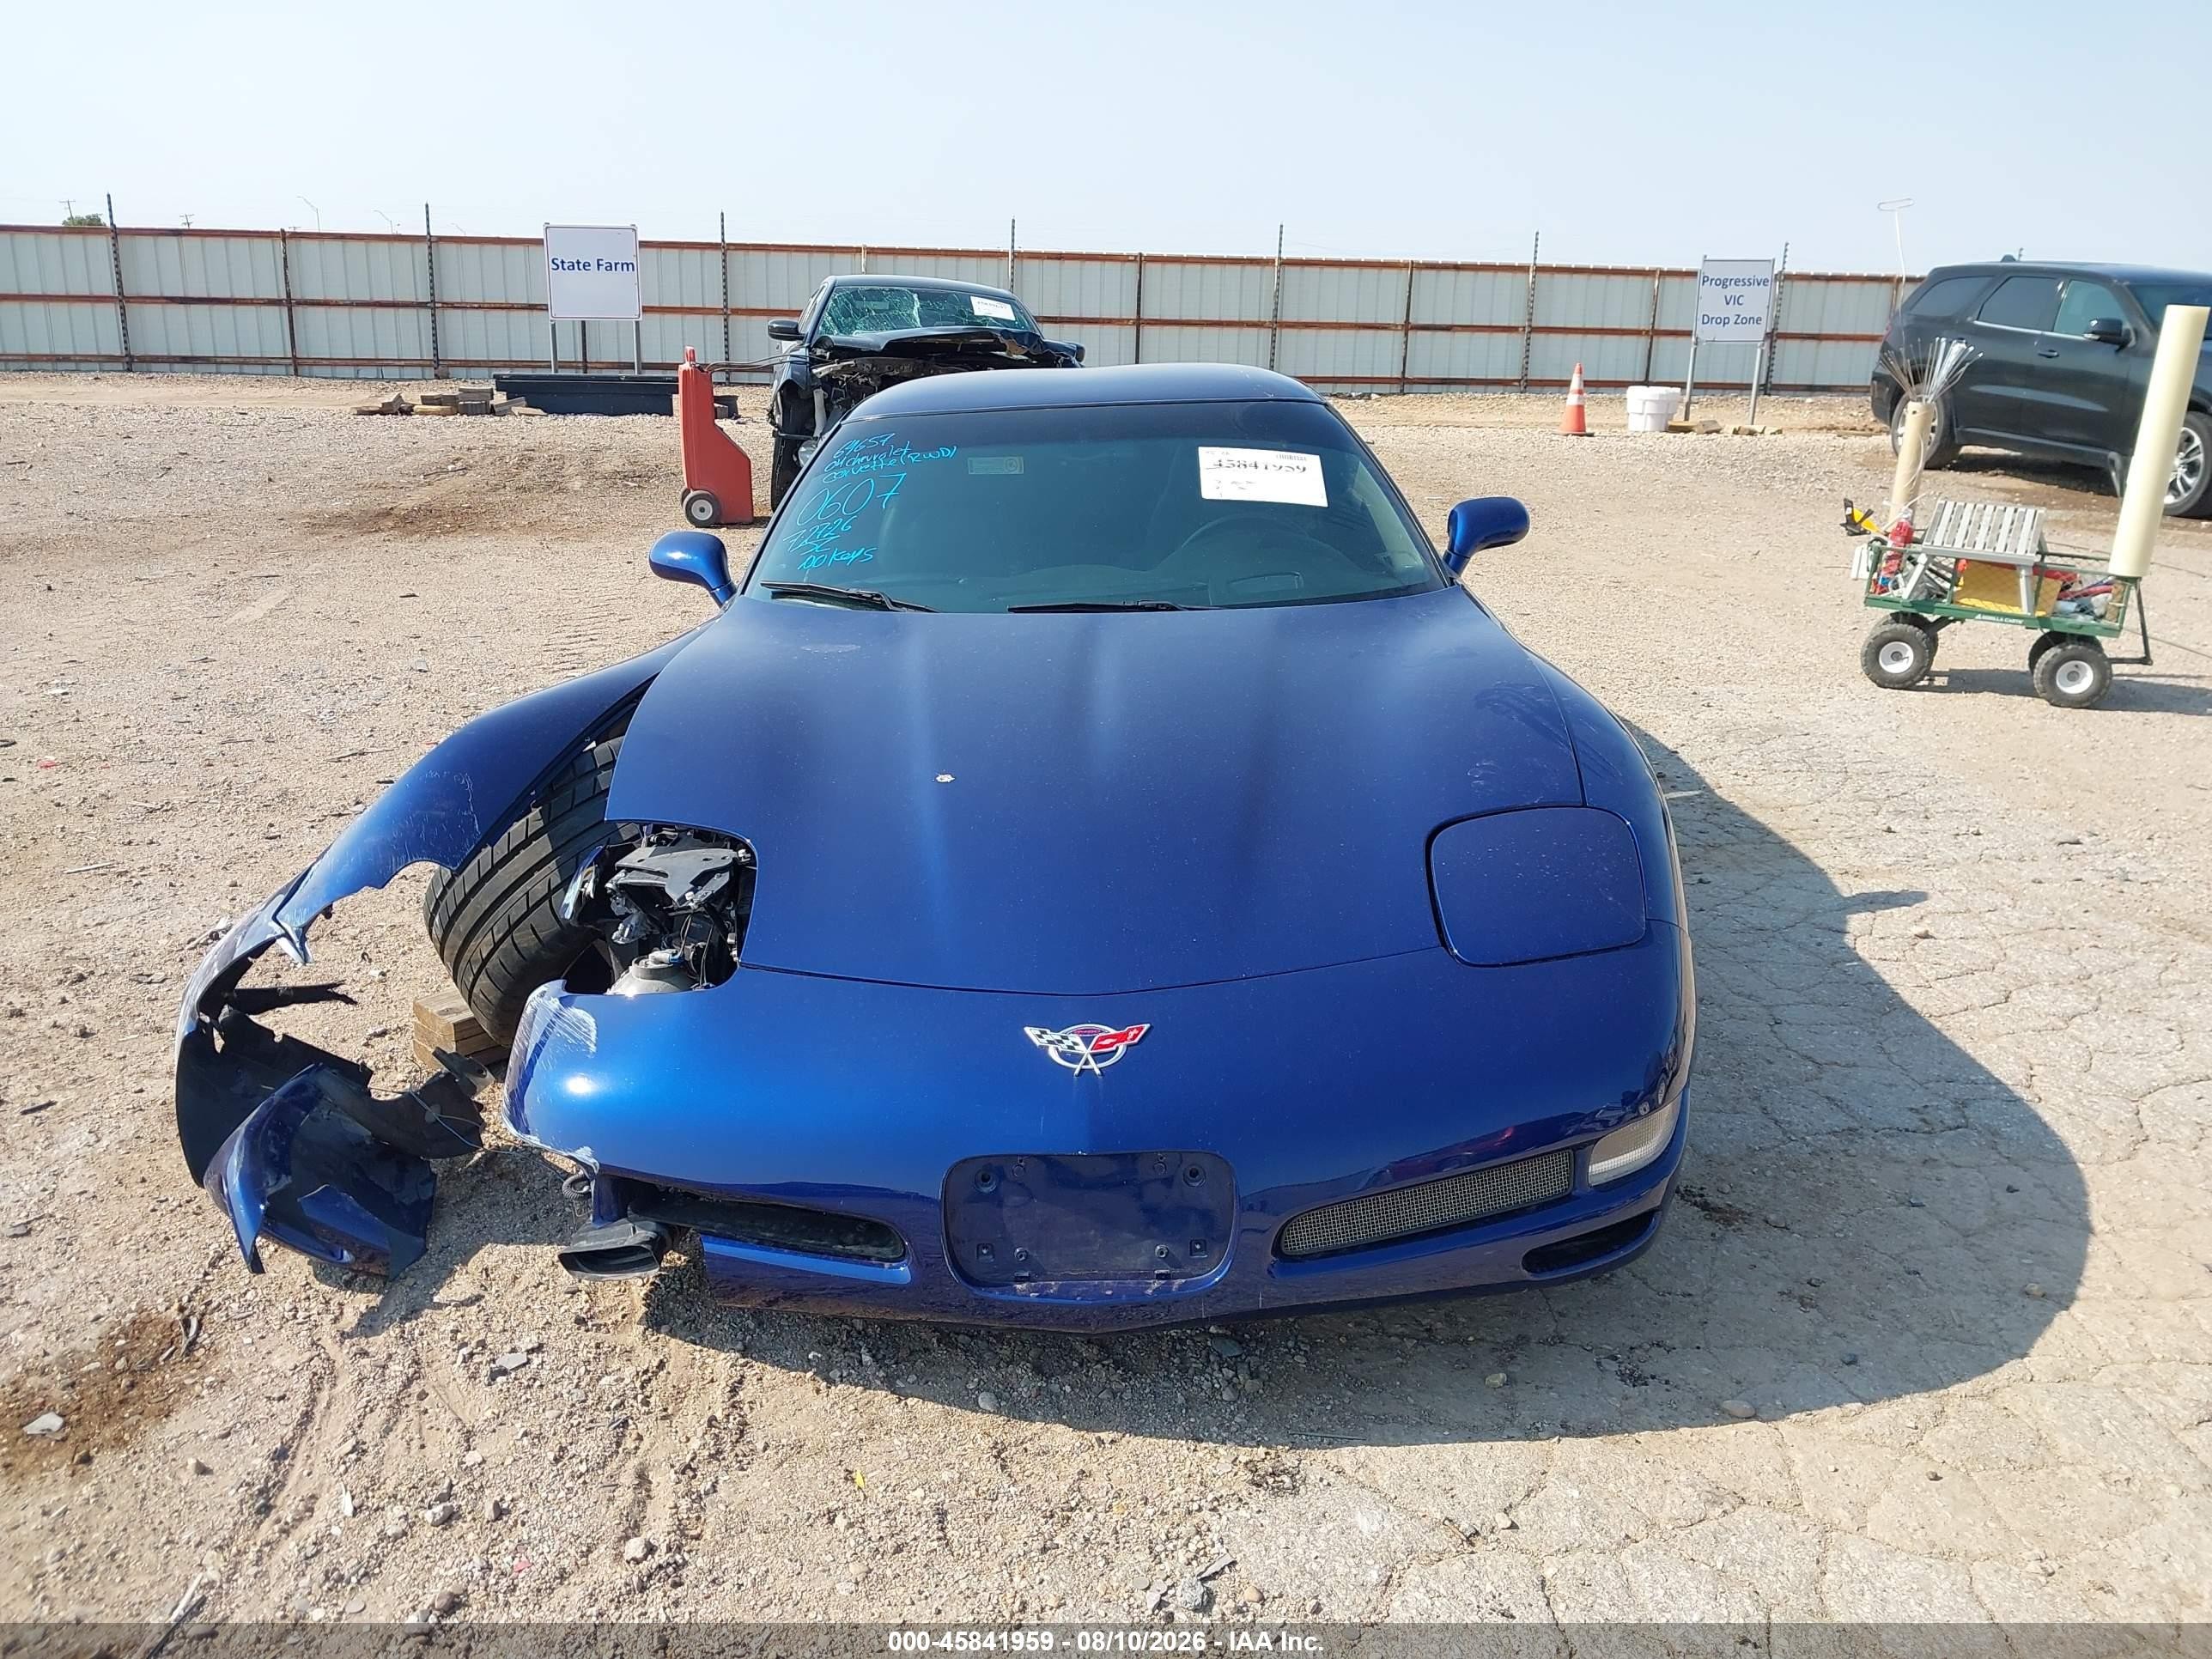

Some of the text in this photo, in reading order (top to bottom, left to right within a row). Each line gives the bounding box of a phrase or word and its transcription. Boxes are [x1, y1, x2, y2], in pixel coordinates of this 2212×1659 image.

[551, 258, 635, 272] State Farm
[1702, 275, 1770, 289] Progressive
[1724, 295, 1744, 305] VIC
[1702, 314, 1762, 327] Drop Zone
[797, 473, 908, 526] 0607
